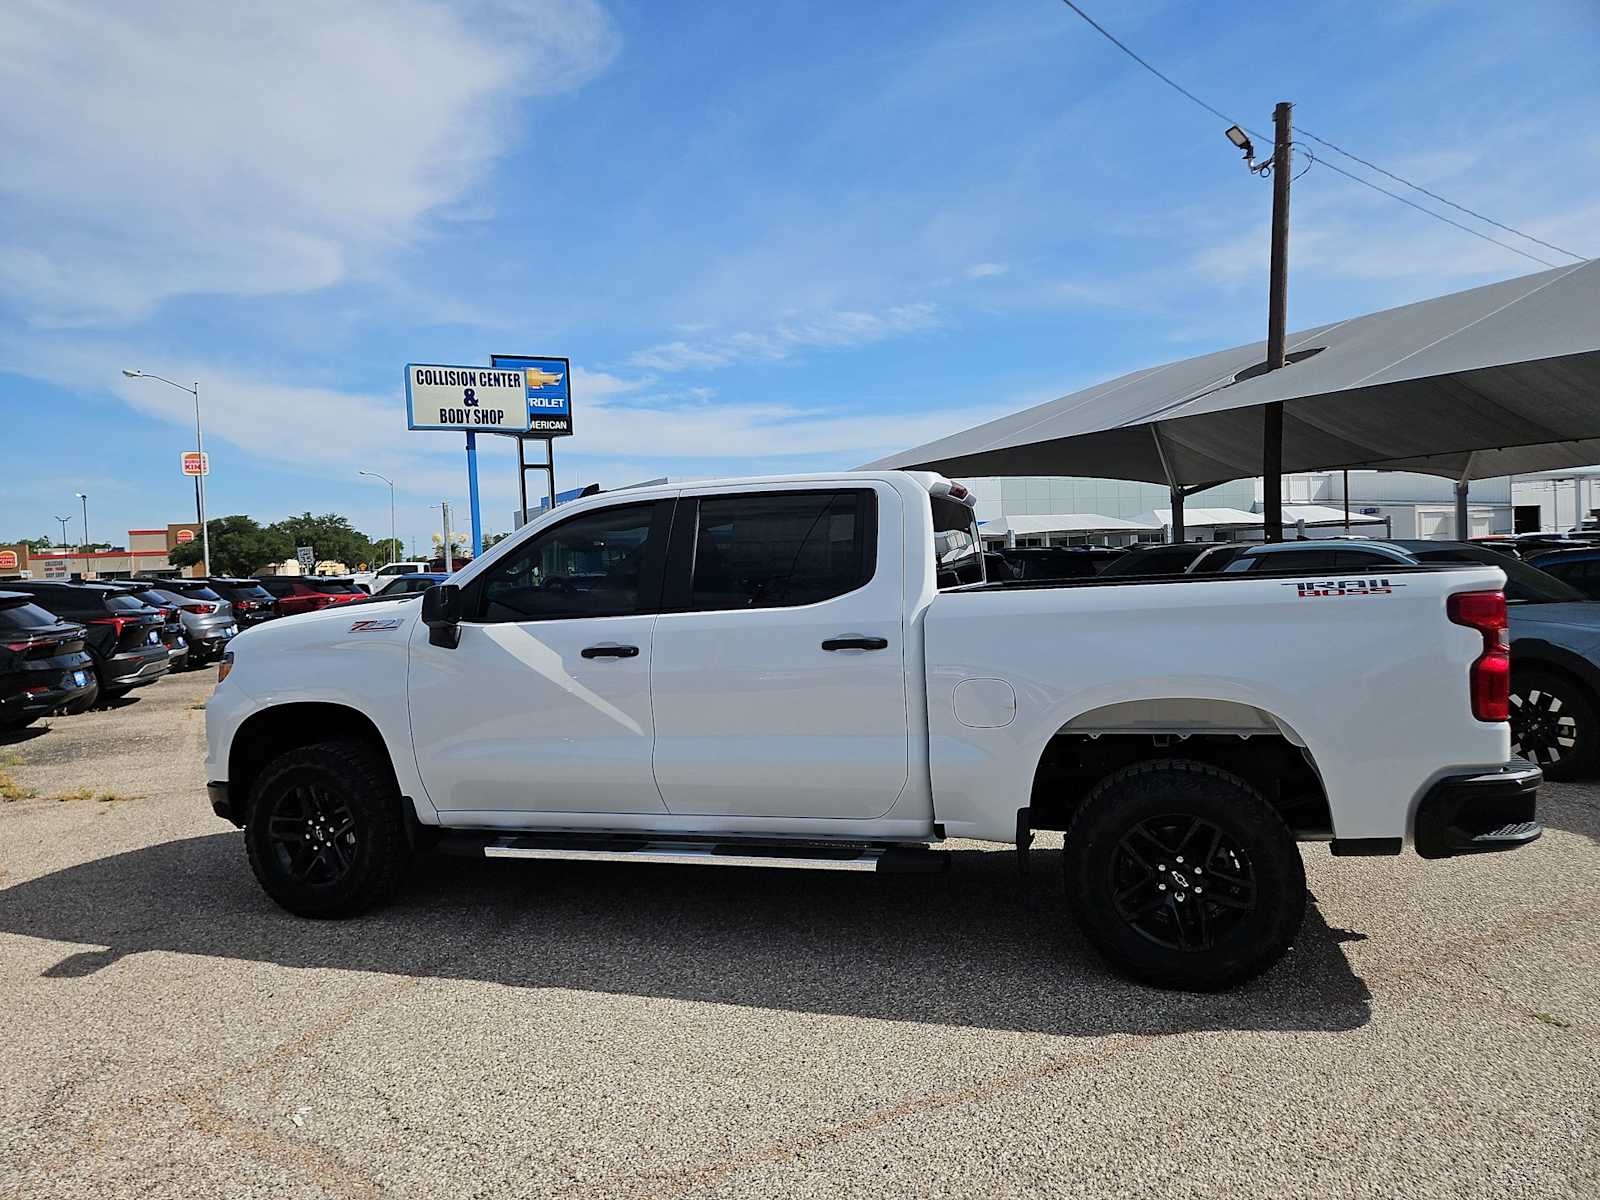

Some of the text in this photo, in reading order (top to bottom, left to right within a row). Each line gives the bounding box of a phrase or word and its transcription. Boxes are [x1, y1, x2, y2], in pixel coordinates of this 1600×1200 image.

[416, 369, 521, 388] COLLISION CENTER
[463, 388, 479, 407] &
[439, 408, 504, 425] BODY SHOP
[1297, 579, 1390, 591] TRAIL
[1298, 587, 1392, 597] BOSS
